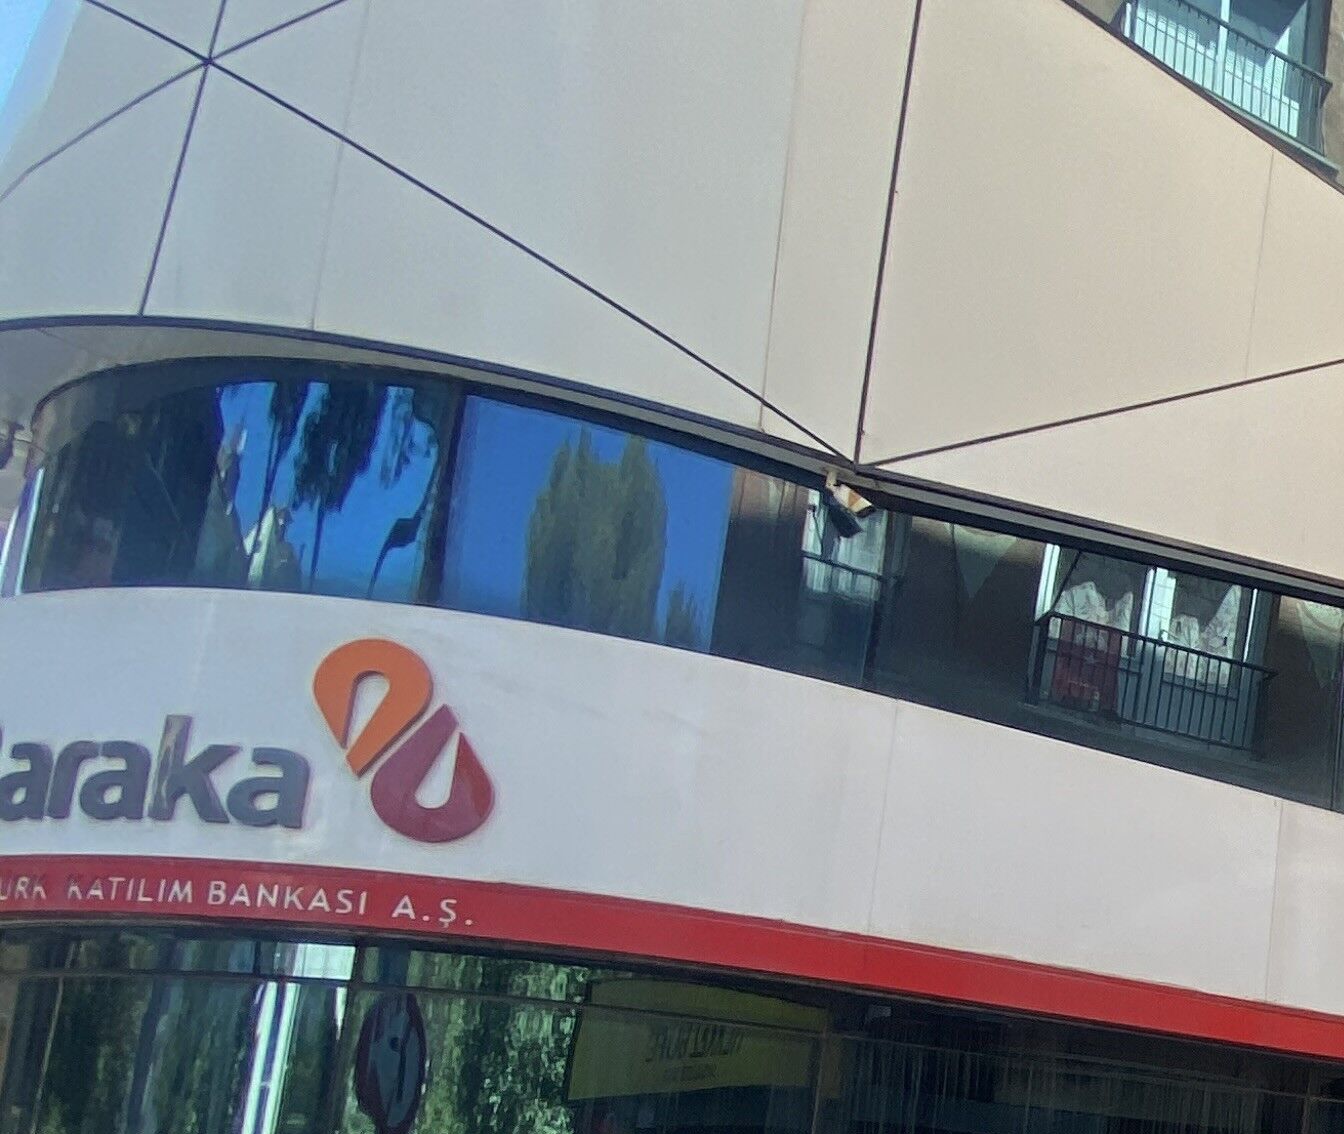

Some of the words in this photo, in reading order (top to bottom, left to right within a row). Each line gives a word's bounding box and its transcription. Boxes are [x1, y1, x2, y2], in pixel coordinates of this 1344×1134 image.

[0, 714, 312, 830] araka
[67, 876, 193, 903] KATILIM
[207, 880, 367, 915] BANKASI
[392, 899, 474, 928] A.Ş.
